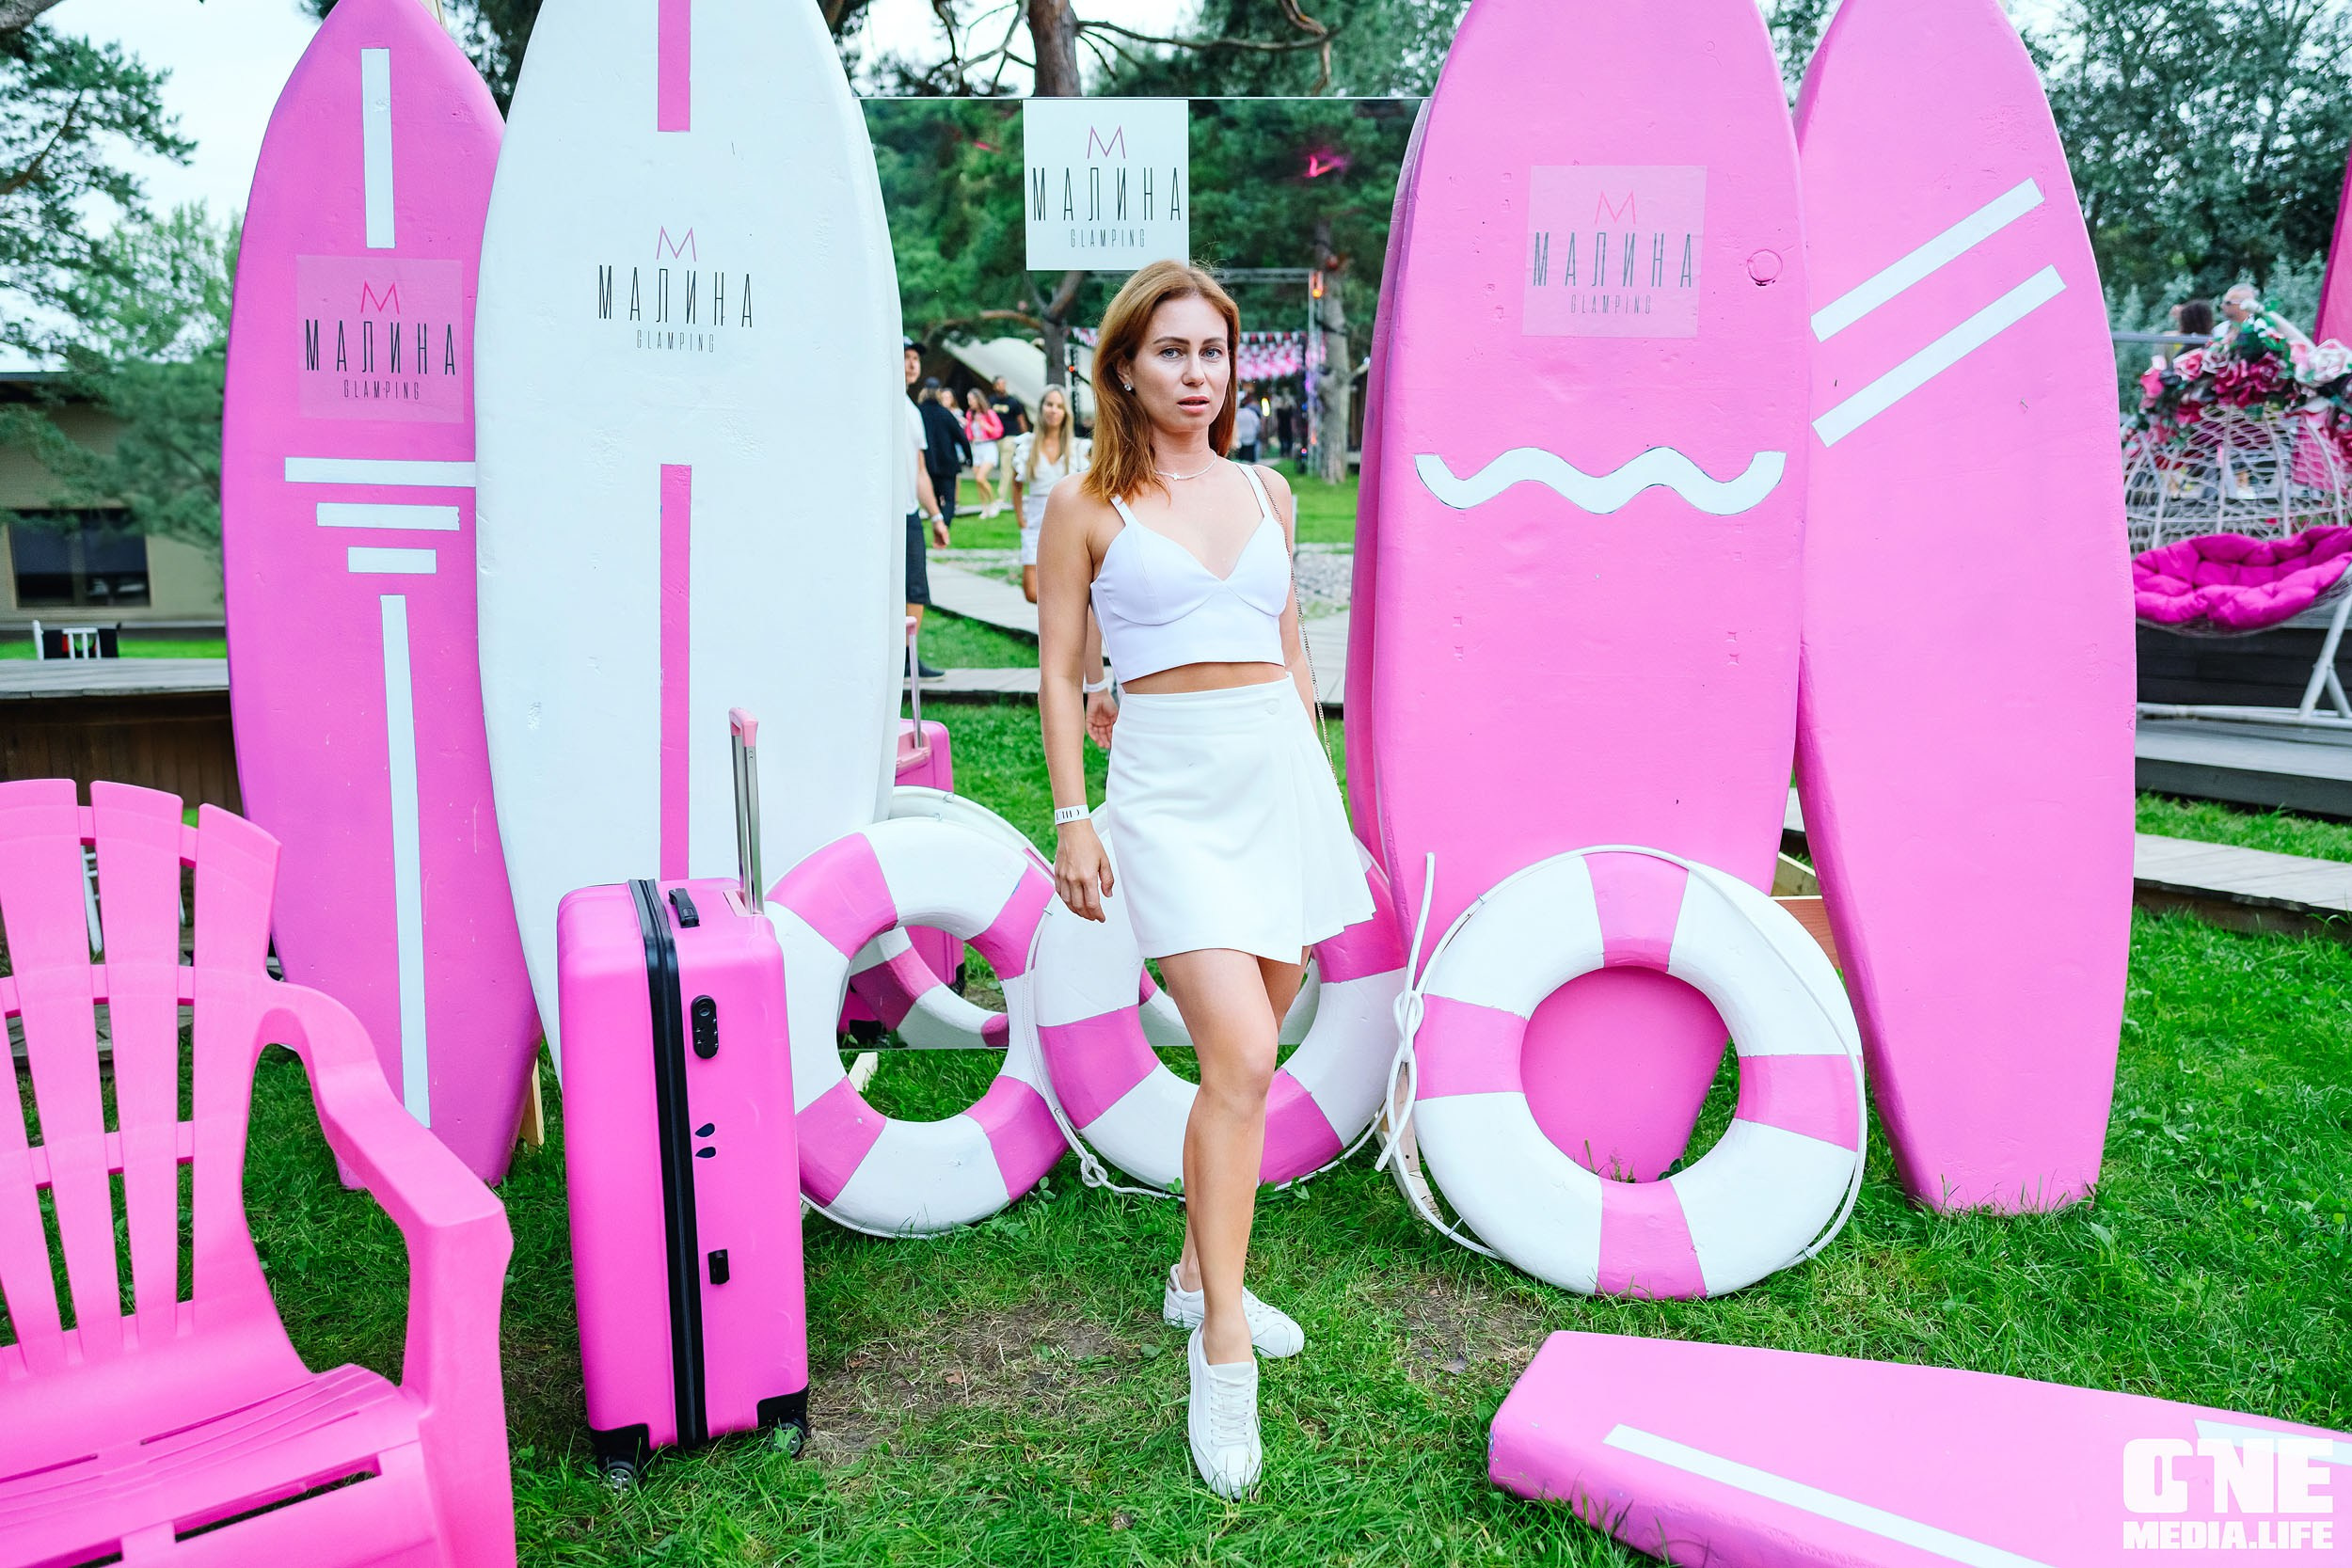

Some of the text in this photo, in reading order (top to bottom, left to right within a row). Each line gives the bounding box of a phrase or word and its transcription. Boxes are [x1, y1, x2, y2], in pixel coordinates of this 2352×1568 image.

[1032, 166, 1182, 221] МАЛИНА
[1070, 229, 1145, 247] GLAMPING
[1533, 231, 1692, 288] МАЛИНА
[598, 264, 753, 328] МАЛИНА
[1570, 294, 1651, 314] GLAMPING
[306, 319, 455, 375] МАЛИНА
[636, 329, 714, 353] GLAMPING
[343, 379, 420, 400] GLAMPING
